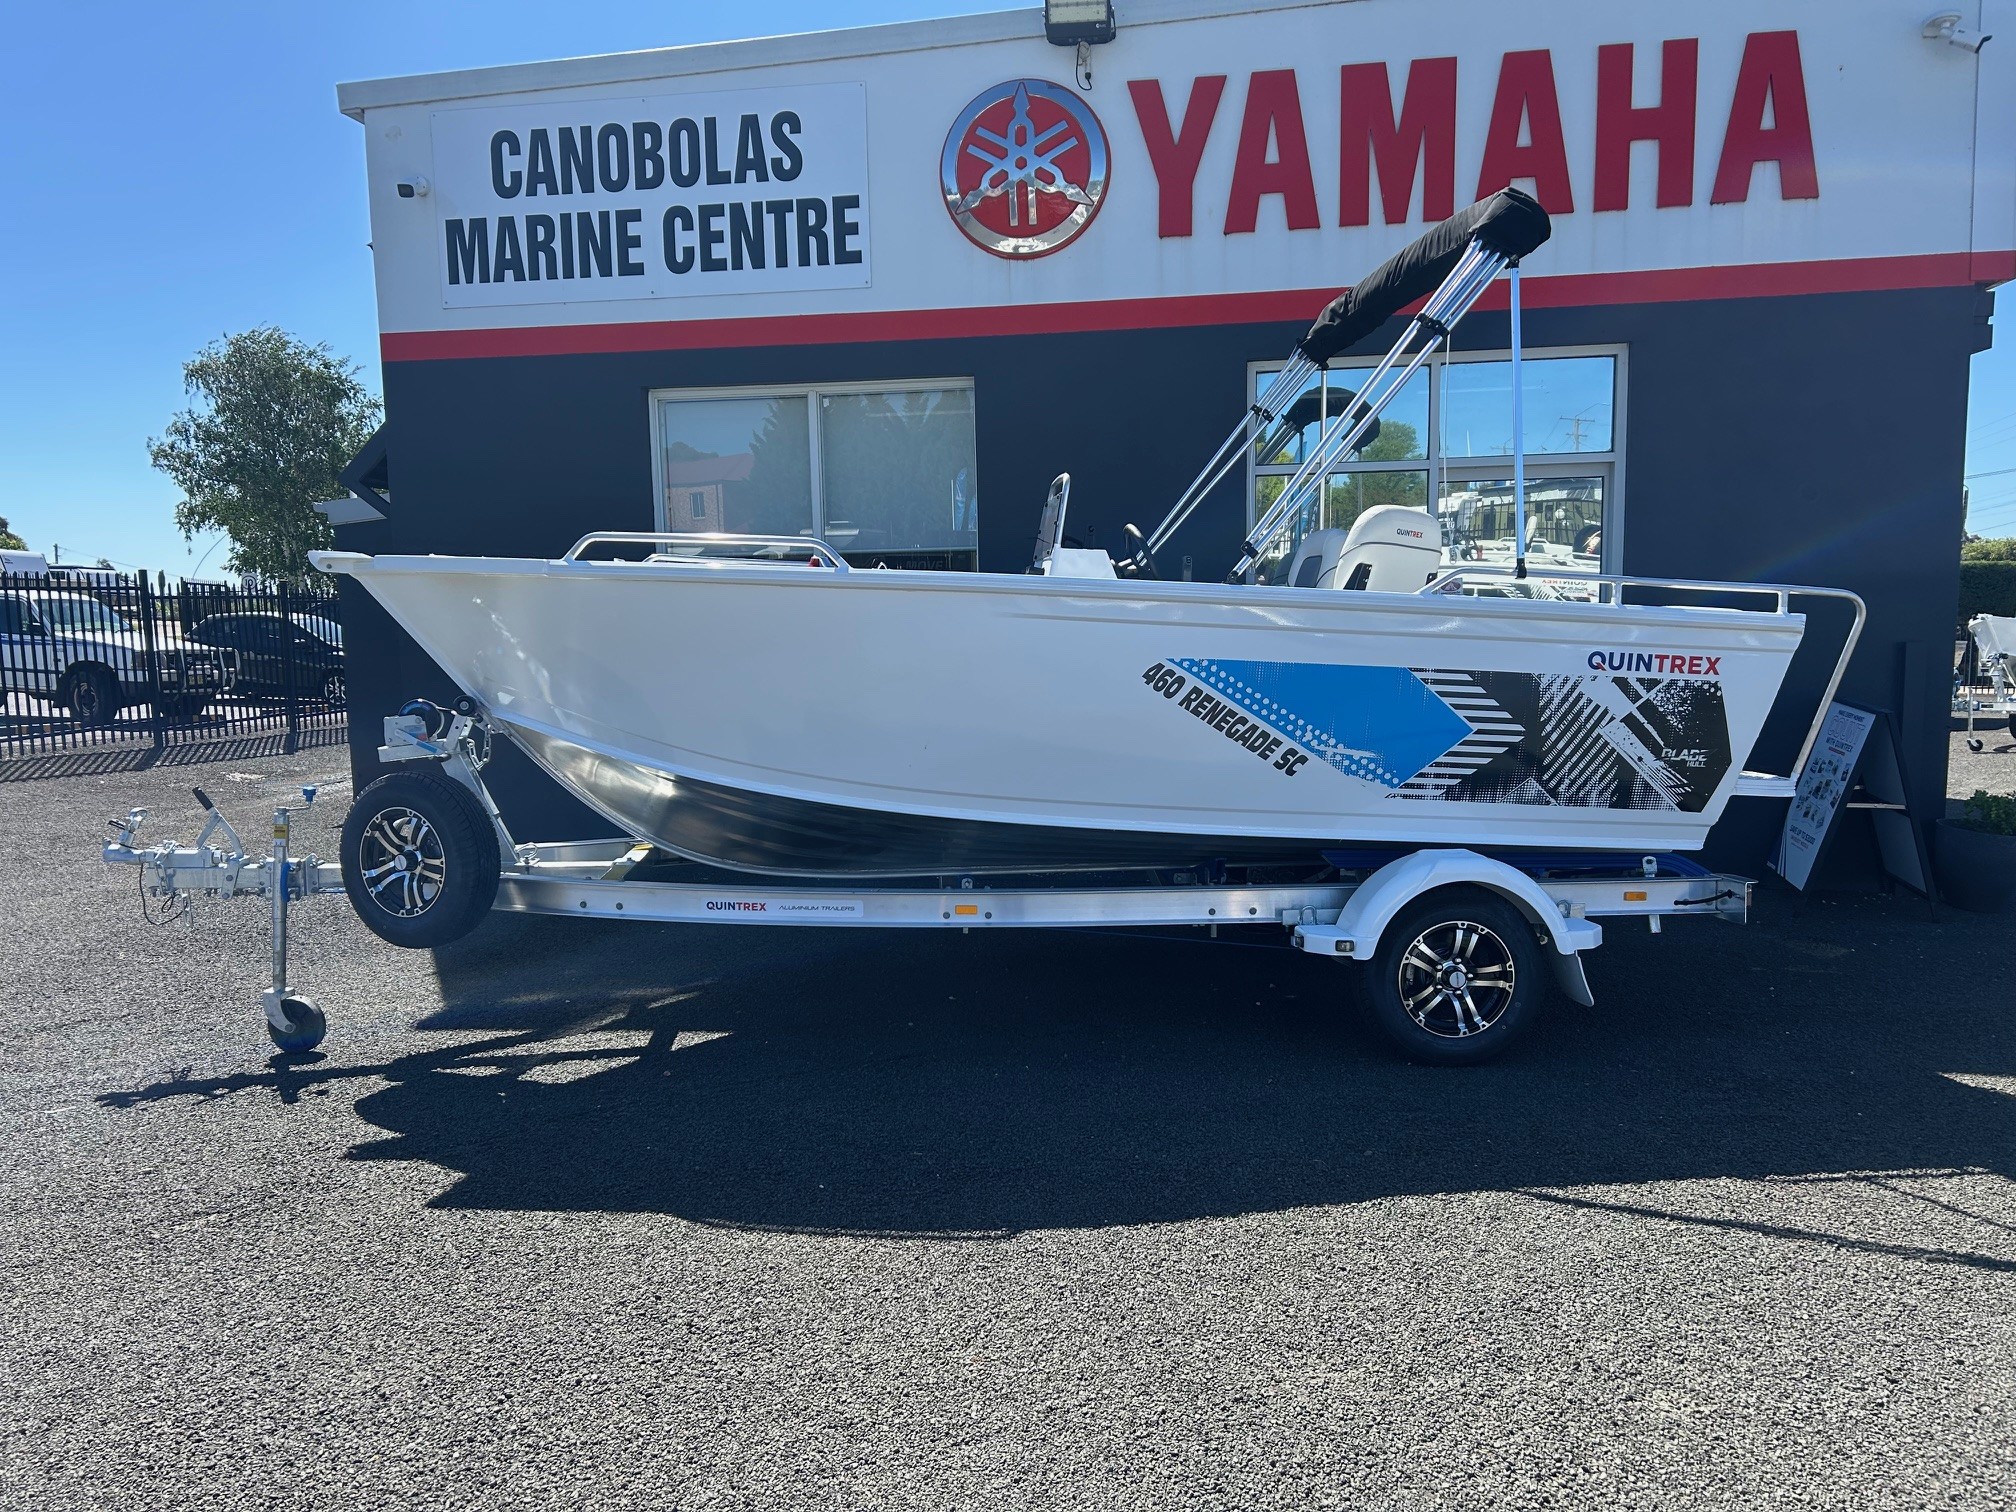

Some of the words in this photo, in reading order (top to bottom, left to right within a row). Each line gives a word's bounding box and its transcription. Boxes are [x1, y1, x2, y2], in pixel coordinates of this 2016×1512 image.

[1127, 30, 1819, 238] YAMAHA
[490, 110, 803, 199] CANOBOLAS
[445, 208, 645, 285] MARINE
[662, 194, 863, 274] CENTRE
[1396, 528, 1423, 538] QUINTREX
[1587, 650, 1722, 676] QUINTREX
[1142, 662, 1186, 699] 460
[1177, 685, 1284, 761] RENEGADE
[1272, 747, 1309, 777] SC
[1661, 748, 1709, 761] BLADE
[1686, 760, 1706, 768] HULL
[706, 901, 767, 912] QUINTREX
